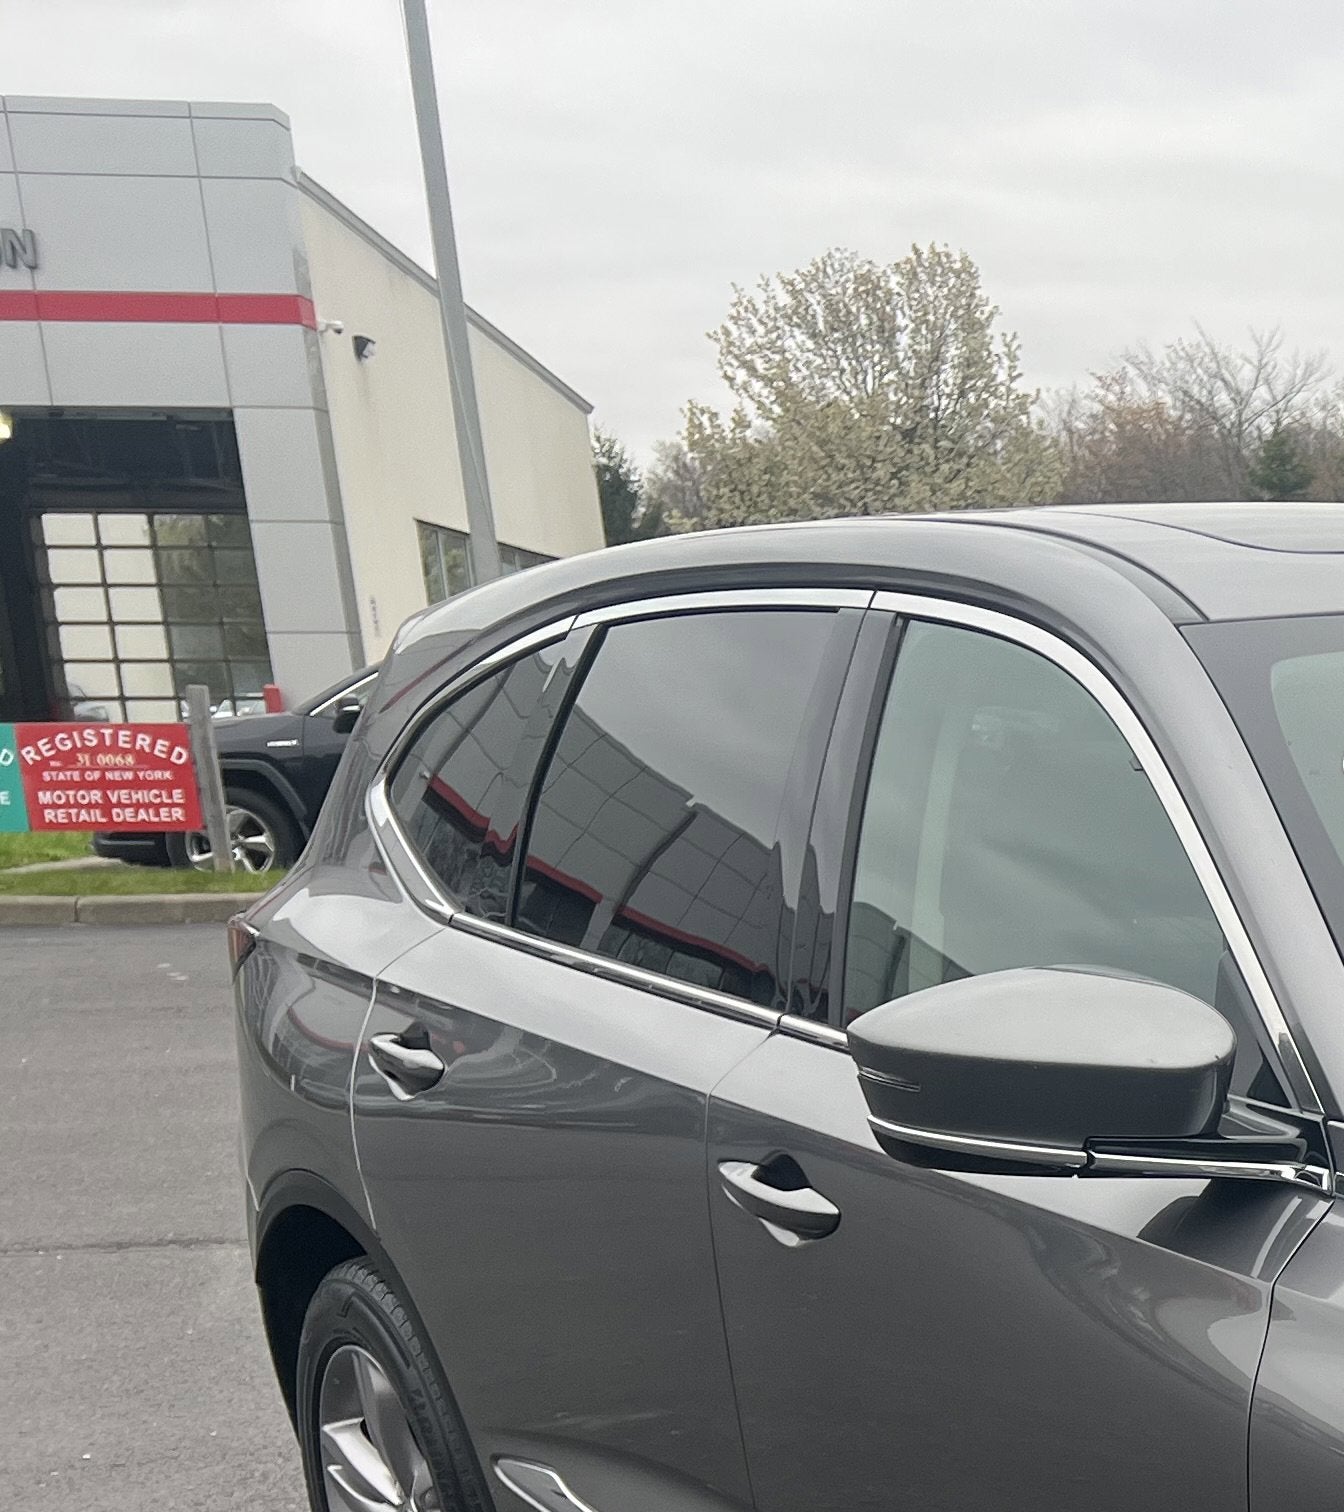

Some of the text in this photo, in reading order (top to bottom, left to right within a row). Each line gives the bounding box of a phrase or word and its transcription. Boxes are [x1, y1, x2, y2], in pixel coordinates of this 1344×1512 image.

[0, 228, 38, 270] N
[21, 728, 188, 765] REGISTERED
[42, 770, 173, 782] STATE OF NEW YORK
[38, 789, 185, 805] MOTOR VEHICLE
[44, 807, 185, 823] RETAIL DEALER
